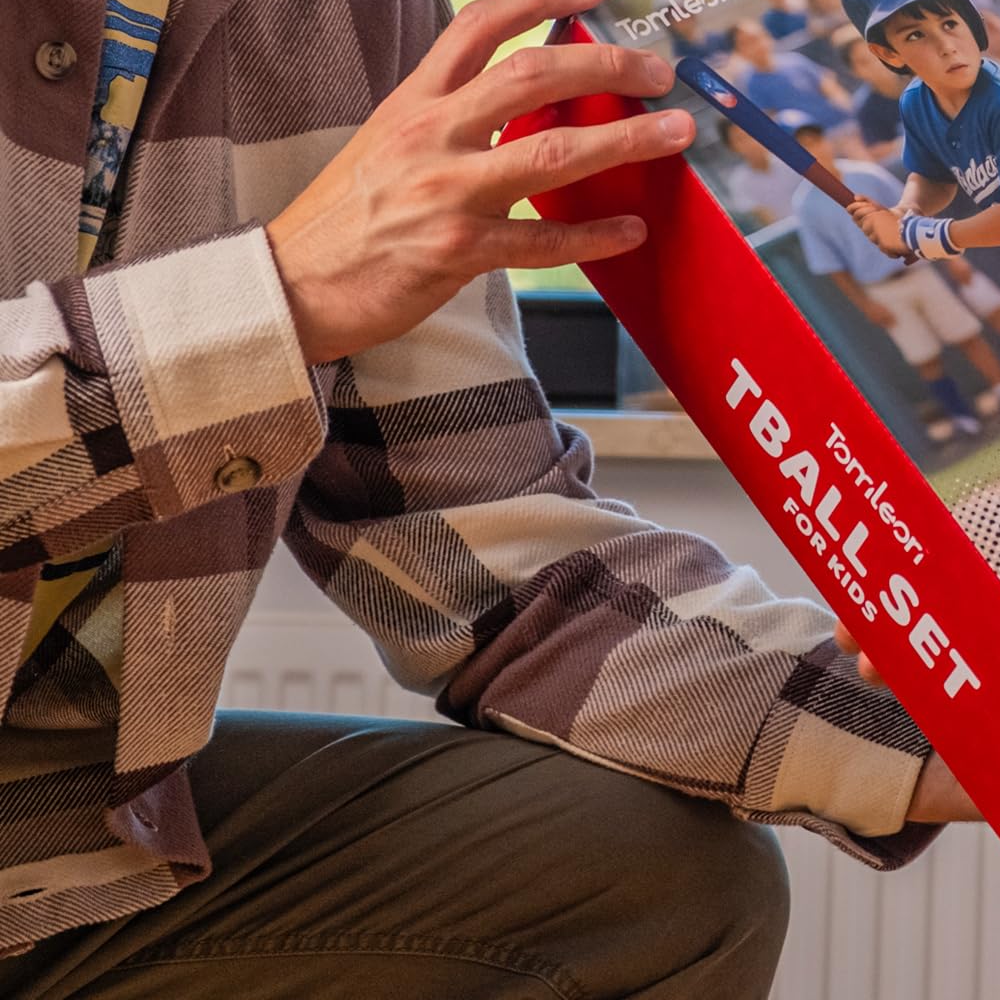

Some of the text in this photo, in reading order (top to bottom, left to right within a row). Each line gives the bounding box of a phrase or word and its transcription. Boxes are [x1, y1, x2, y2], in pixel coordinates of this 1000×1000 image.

[725, 357, 982, 699] TBALL SET
[782, 496, 878, 623] FOR KIDS
